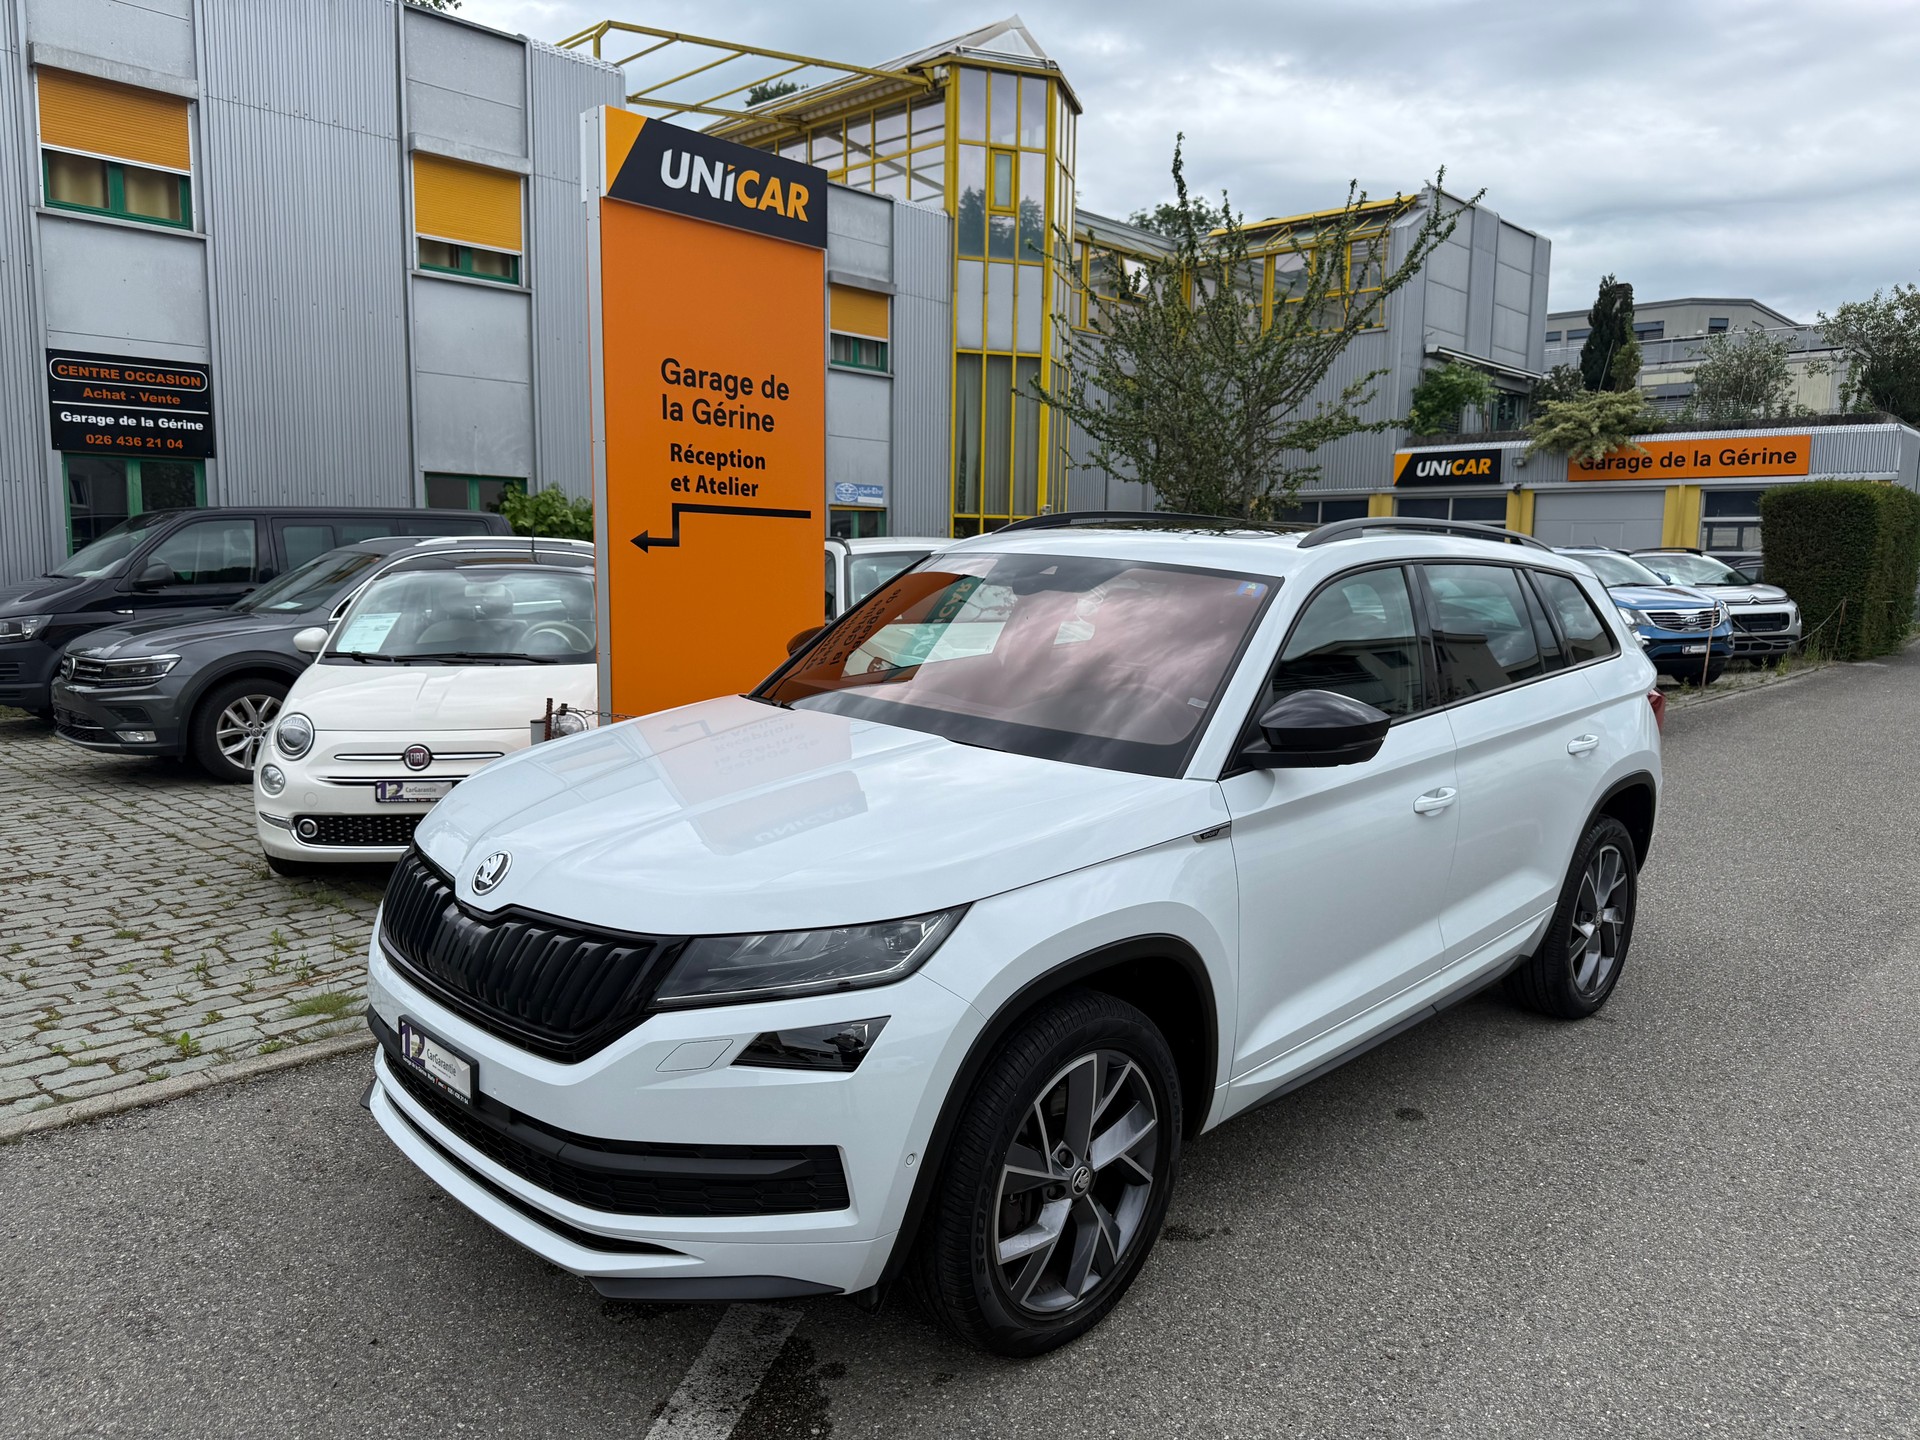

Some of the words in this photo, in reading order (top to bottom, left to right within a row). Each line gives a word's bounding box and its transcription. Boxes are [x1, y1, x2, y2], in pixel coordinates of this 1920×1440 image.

[660, 148, 809, 223] UNiCAR
[57, 364, 120, 380] CENTRE
[124, 371, 201, 387] OCCASION
[660, 357, 754, 400] Garage
[761, 374, 790, 401] de
[83, 387, 126, 400] Achat
[139, 392, 181, 405] Vente
[60, 411, 115, 426] Garage
[119, 414, 137, 427] de
[141, 416, 154, 428] la
[158, 418, 204, 431] Gérine
[662, 393, 684, 422] la
[692, 398, 775, 433] Gérine
[86, 434, 112, 446] 026
[117, 435, 142, 447] 436
[146, 437, 162, 448] 21
[167, 438, 184, 449] 04
[670, 443, 766, 471] Réception
[1579, 453, 1653, 473] Garage
[1659, 451, 1686, 469] de
[1693, 450, 1711, 467] la
[1719, 447, 1797, 466] Gérine
[670, 475, 690, 493] et
[695, 474, 759, 497] Atelier
[410, 752, 424, 764] FIAT
[426, 1048, 457, 1076] CarGarantie
